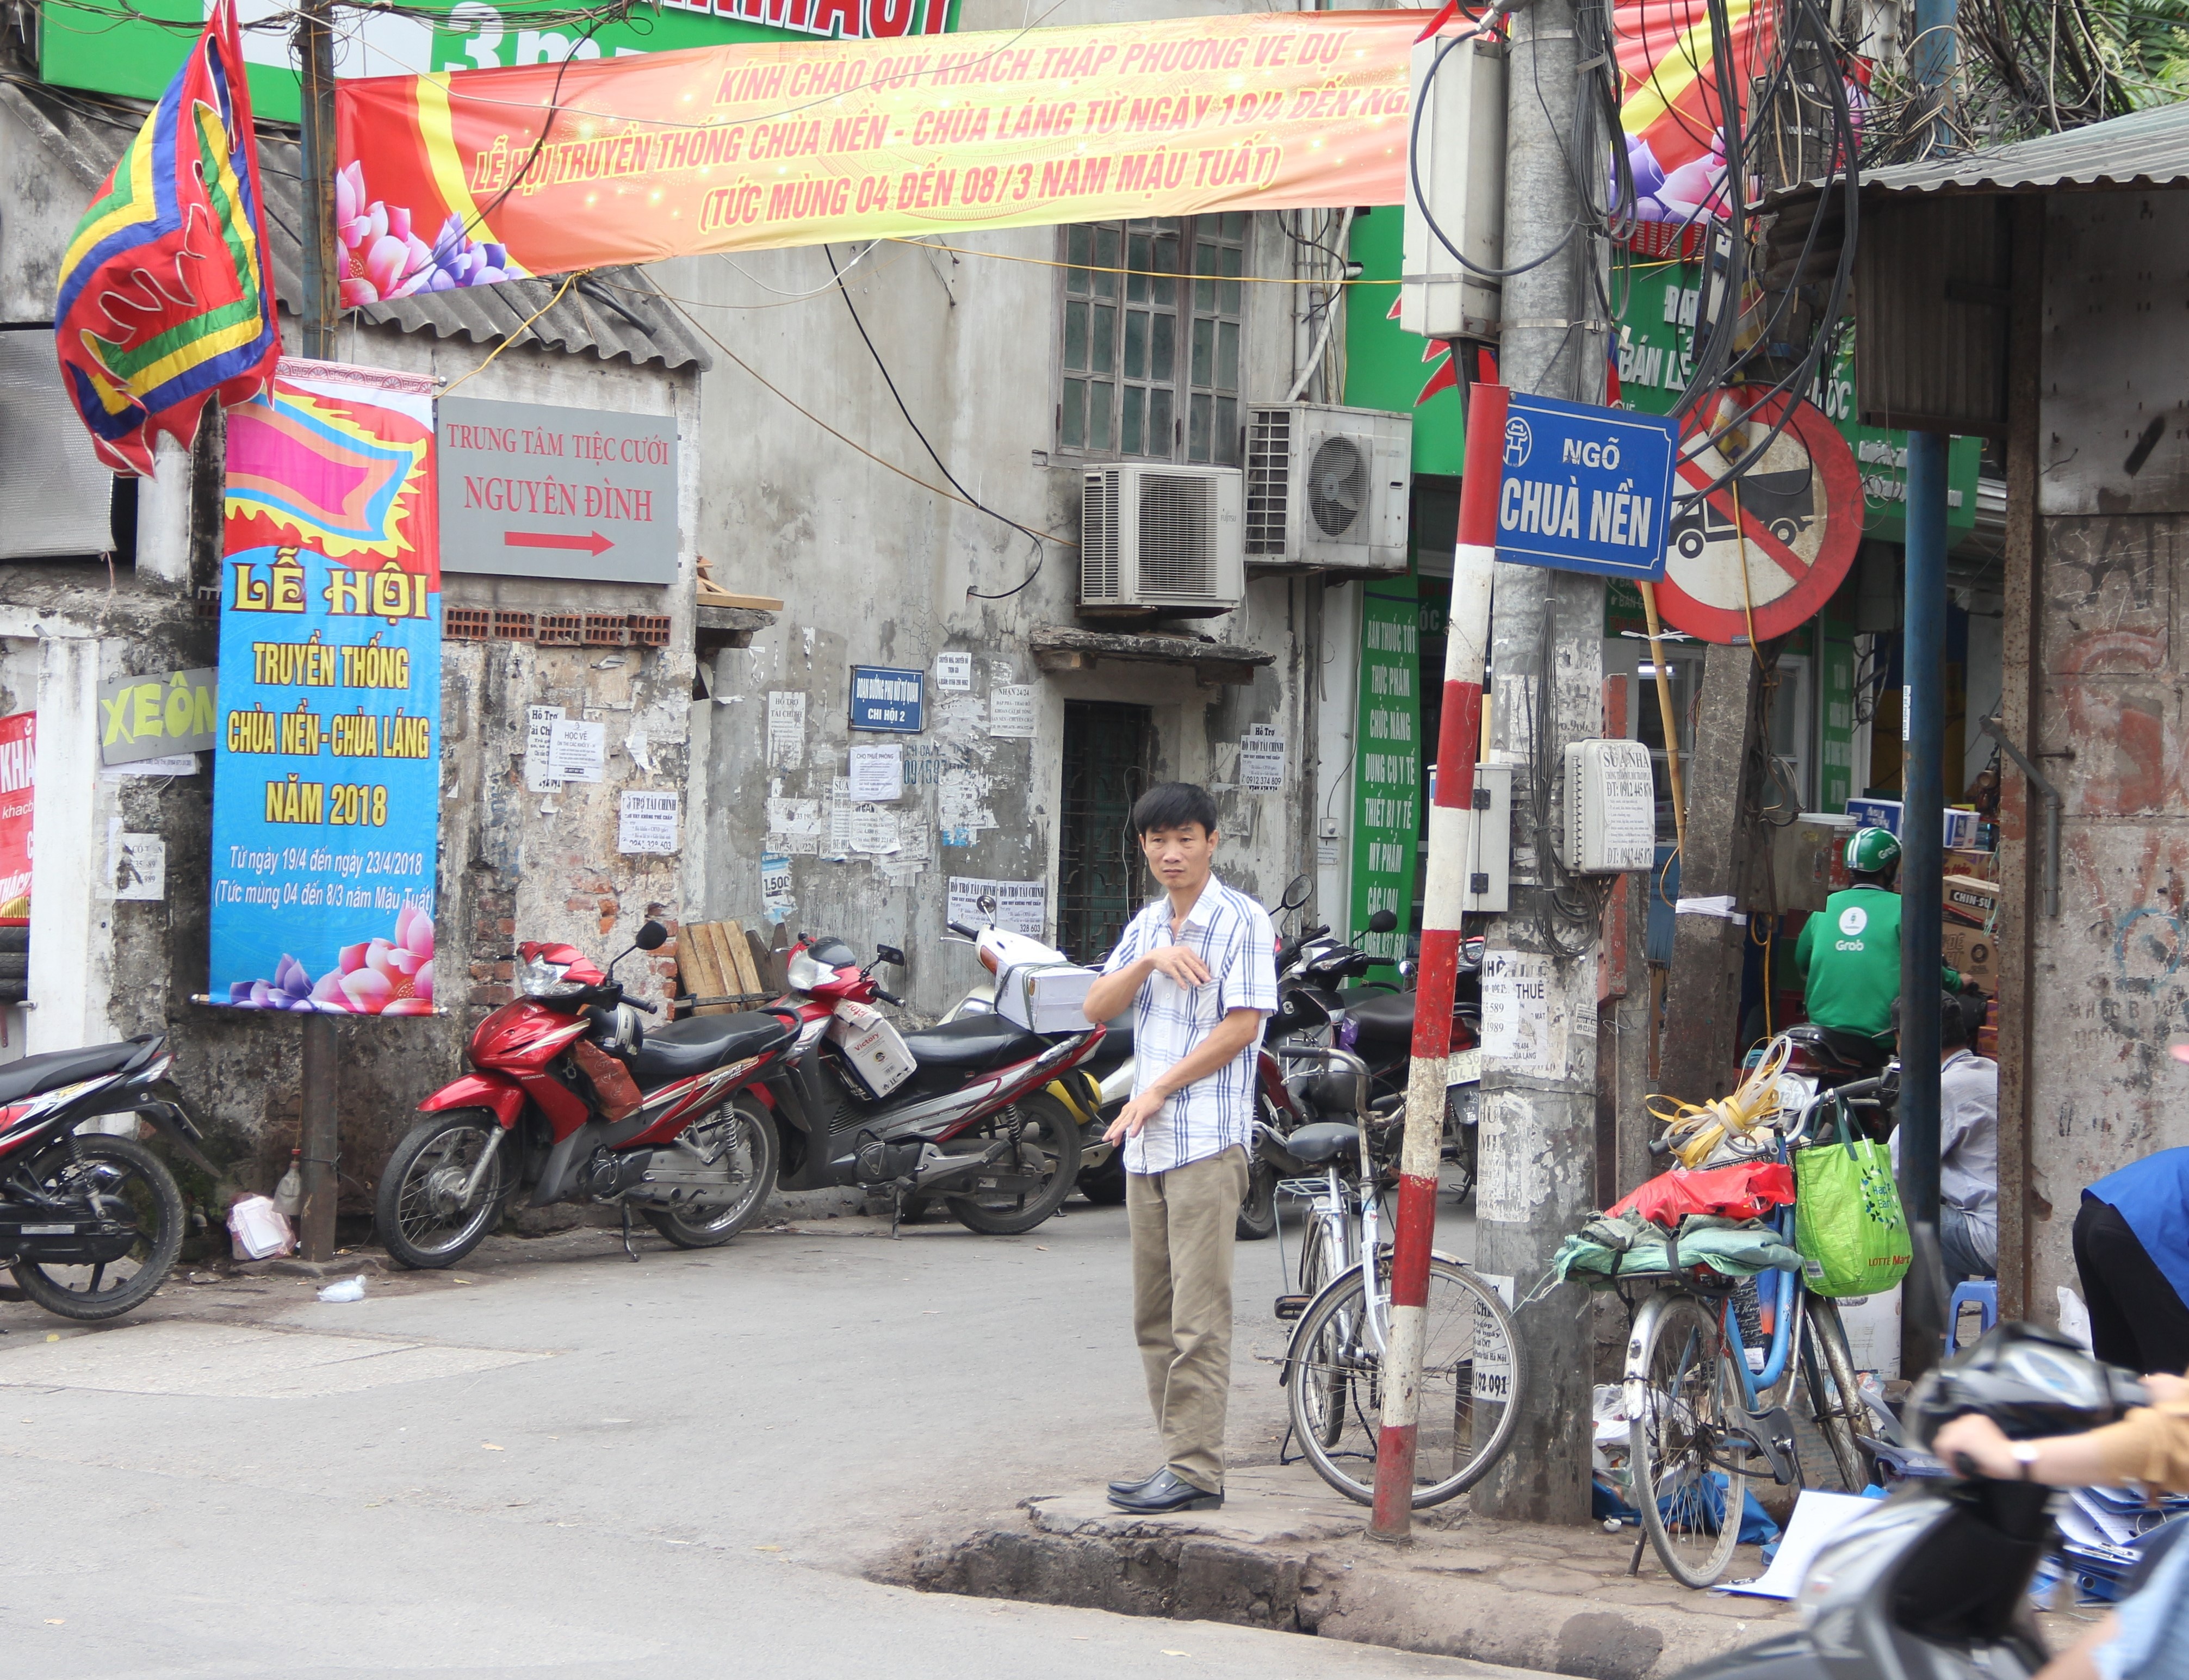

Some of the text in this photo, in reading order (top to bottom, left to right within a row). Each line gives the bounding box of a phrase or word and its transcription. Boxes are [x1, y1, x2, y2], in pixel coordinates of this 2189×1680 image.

[714, 24, 1354, 106] KÍNH CHÀO QUÝ KHÁCH THẬP PHƯƠNG VỀ DỰ
[470, 134, 509, 194] LỄ
[554, 121, 653, 185] TRUYỀN
[654, 114, 746, 172] THỐNG
[748, 114, 821, 162] CHÙA
[826, 103, 892, 154] NỀN
[912, 101, 990, 147] CHÙA
[994, 96, 1077, 141] LÁNG
[1083, 90, 1128, 134] TỪ
[1124, 88, 1214, 133] NGÀY
[1217, 89, 1284, 128] 19/4
[1286, 72, 1362, 122] ĐẾN
[699, 131, 1284, 234] (TỨC MÙNG 04 ĐẾN 08/3 NĂM MẬU TUẤT)
[1618, 334, 1663, 388] BÁN
[447, 423, 669, 466] TRUNG TÂM TIỆC CƯỚI
[1563, 436, 1620, 470] NGÕ
[463, 475, 653, 522] NGUYÊN ĐÌNH
[1589, 478, 1652, 548] NỀN
[229, 547, 432, 626] LỄ HỘI
[1367, 613, 1415, 653] BÁN THUỐC TỐT
[253, 629, 410, 690] TRUYỀN THỐNG
[1372, 656, 1410, 700] THỰC PHẨM
[227, 702, 276, 754] CHÙA
[382, 707, 429, 759] LÁNG
[868, 708, 905, 723] CHI HỘI 2
[1255, 725, 1275, 736] Hỗ Trợ
[1370, 704, 1411, 741] CHỨC NĂNG
[565, 731, 578, 741] HỌC
[1250, 740, 1259, 754] TRỢ
[1269, 740, 1283, 752] CHÍNH
[1365, 747, 1415, 790] DỤNG CỤ Y TẾ
[1628, 748, 1649, 768] NHÀ
[266, 773, 388, 827] NĂM 2018
[646, 795, 656, 810] TÀI
[658, 796, 677, 811] CHÍNH
[1607, 782, 1619, 796] ĐT:
[1620, 782, 1633, 797] 0912
[1635, 782, 1643, 797] 445
[1365, 789, 1413, 834] THIẾT BỊ Y TẾ
[230, 845, 422, 878] Từ ngày 19/4 đến ngày 23/4/2018
[1369, 837, 1381, 871] MỸ
[1381, 832, 1403, 872] PHẨM
[1607, 848, 1619, 864] ĐT:
[1635, 848, 1643, 864] 445
[1878, 844, 1897, 859] Grab
[215, 879, 241, 906] (Tức
[245, 881, 280, 909] mùng
[283, 883, 297, 903] 04
[301, 880, 323, 906] đến
[326, 884, 343, 906] 8/3
[346, 886, 371, 908] năm
[374, 886, 400, 915] Mậu
[959, 882, 969, 897] TRỢ
[971, 881, 979, 894] TÀI
[980, 882, 996, 896] CHÍNH
[1008, 885, 1018, 900] TRỢ
[1020, 884, 1028, 897] TÀI
[1028, 884, 1044, 897] CHÍNH
[1368, 881, 1381, 915] CÁC
[1835, 940, 1864, 951] Grab
[1516, 980, 1544, 999] THUÊ
[854, 1032, 879, 1051] Victory
[1869, 1254, 1911, 1266] LOTTE Mart
